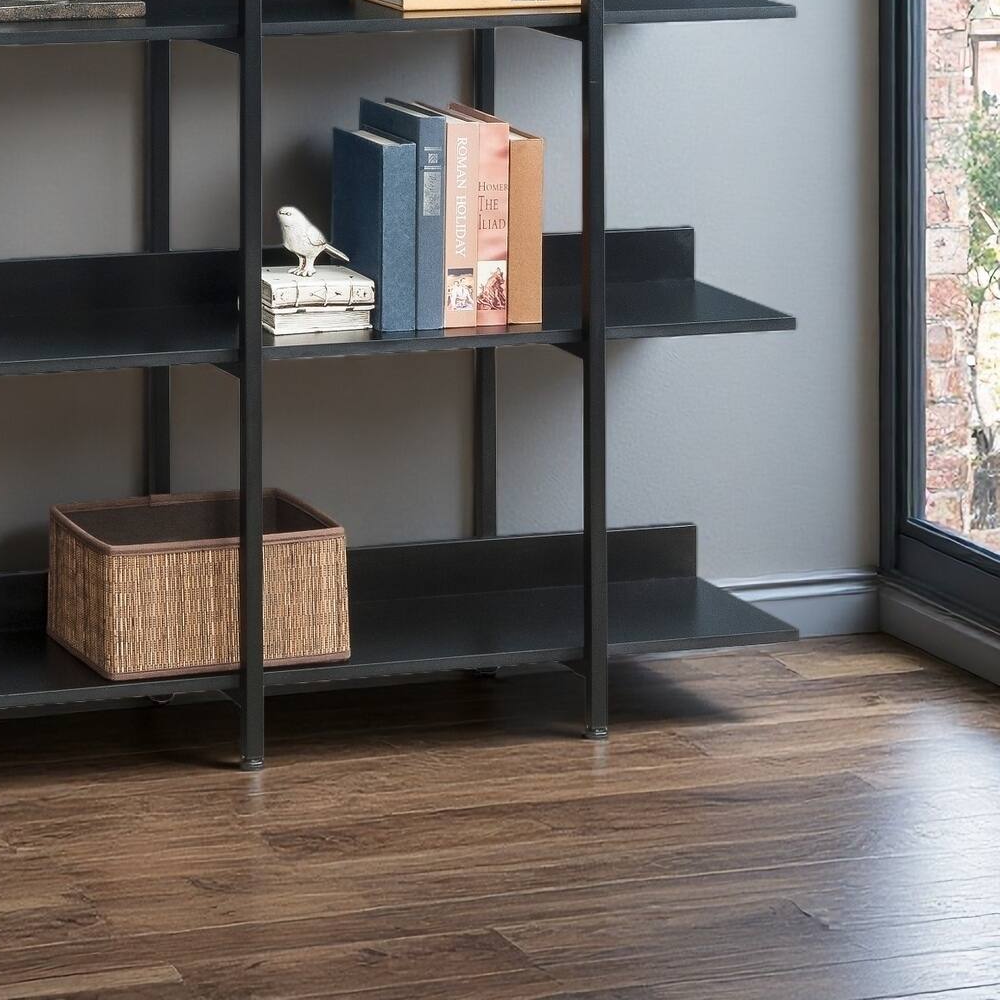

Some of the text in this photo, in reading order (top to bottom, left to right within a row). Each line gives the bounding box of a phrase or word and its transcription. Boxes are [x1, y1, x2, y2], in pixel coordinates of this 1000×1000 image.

[455, 136, 468, 258] ROMAN HOLIDAY
[478, 195, 499, 212] THE
[478, 214, 506, 230] ILIAD
